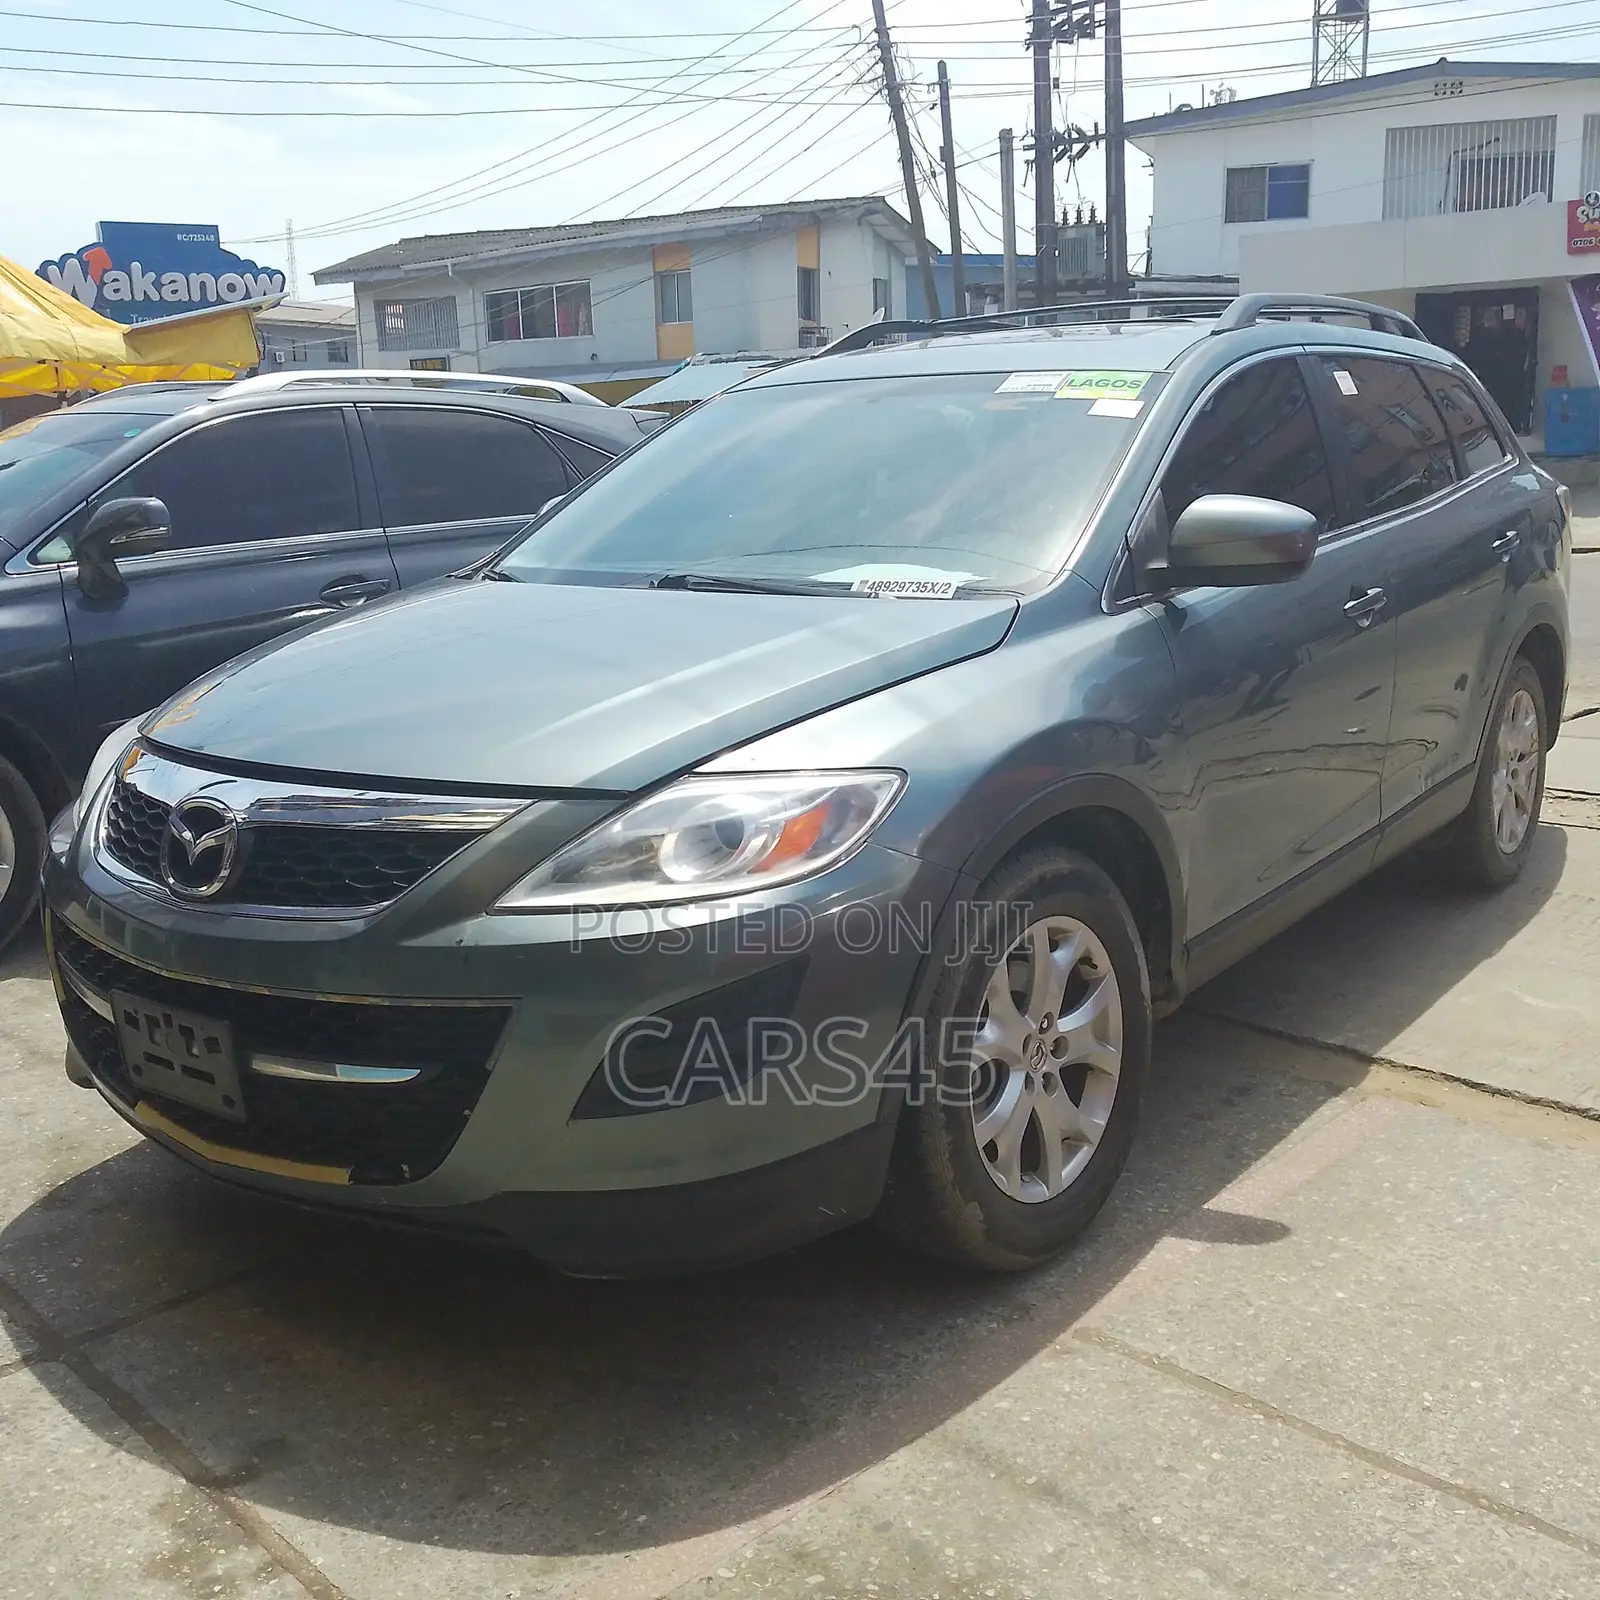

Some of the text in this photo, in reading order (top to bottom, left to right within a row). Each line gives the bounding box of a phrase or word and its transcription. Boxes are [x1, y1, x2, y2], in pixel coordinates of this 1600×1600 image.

[46, 250, 283, 309] Wakanow
[1066, 379, 1143, 389] LAGOS
[866, 581, 952, 594] 48929735X/2
